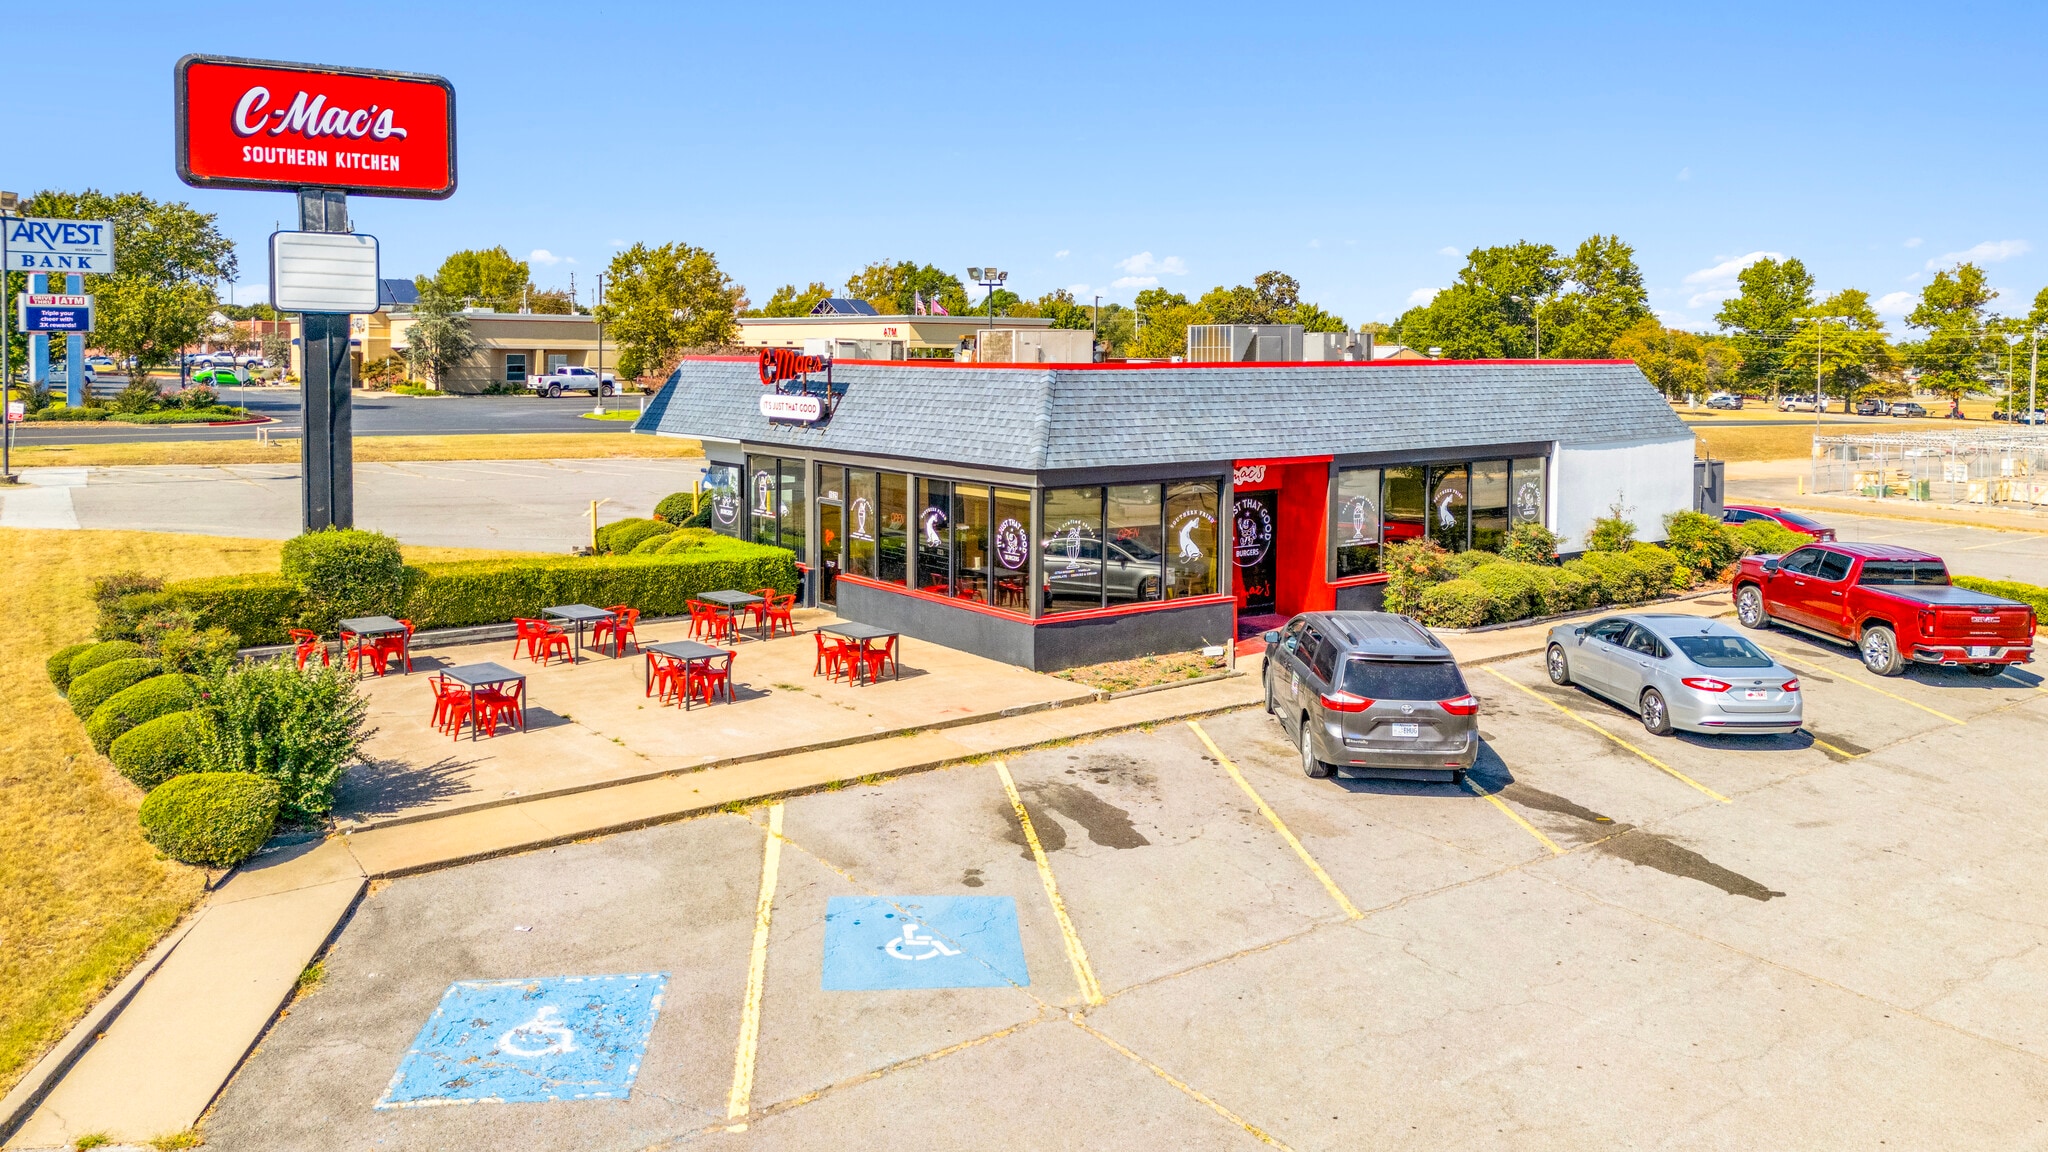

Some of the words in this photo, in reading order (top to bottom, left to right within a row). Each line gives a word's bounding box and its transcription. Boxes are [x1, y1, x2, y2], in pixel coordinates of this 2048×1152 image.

[231, 86, 407, 141] C-Mac's
[242, 145, 328, 167] SOUTHERN
[335, 151, 400, 172] KITCHEN
[10, 221, 103, 250] ARVEST
[21, 254, 92, 269] BANK
[60, 297, 84, 305] ATM
[884, 327, 897, 336] ATM
[772, 402, 785, 411] JUST
[785, 402, 798, 412] THAT
[799, 403, 817, 413] GOOD
[1170, 510, 1198, 528] SOUTHERN
[1233, 501, 1241, 516] ST
[1242, 499, 1262, 510] THAT
[1260, 509, 1272, 541] GOOD
[999, 520, 1009, 535] JUST
[1008, 519, 1021, 530] THAT
[1020, 529, 1028, 554] GOOD
[1118, 528, 1139, 541] OPEN
[1236, 548, 1260, 558] BURGERS
